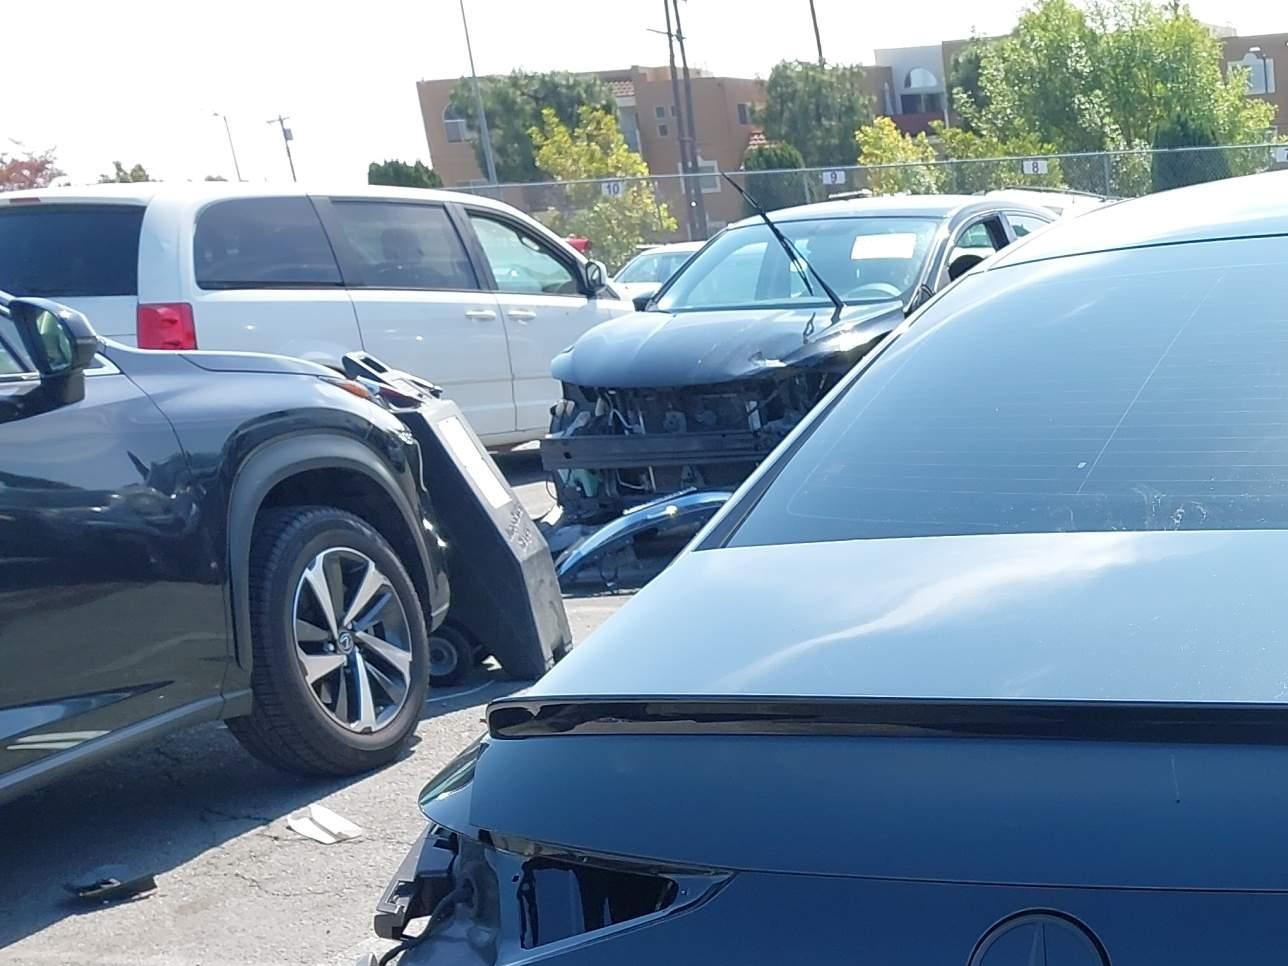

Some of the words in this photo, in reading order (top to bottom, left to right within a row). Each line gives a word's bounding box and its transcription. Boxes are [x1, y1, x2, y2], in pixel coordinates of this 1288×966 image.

[1032, 161, 1039, 174] 8
[830, 171, 837, 184] 9
[606, 182, 620, 195] 10
